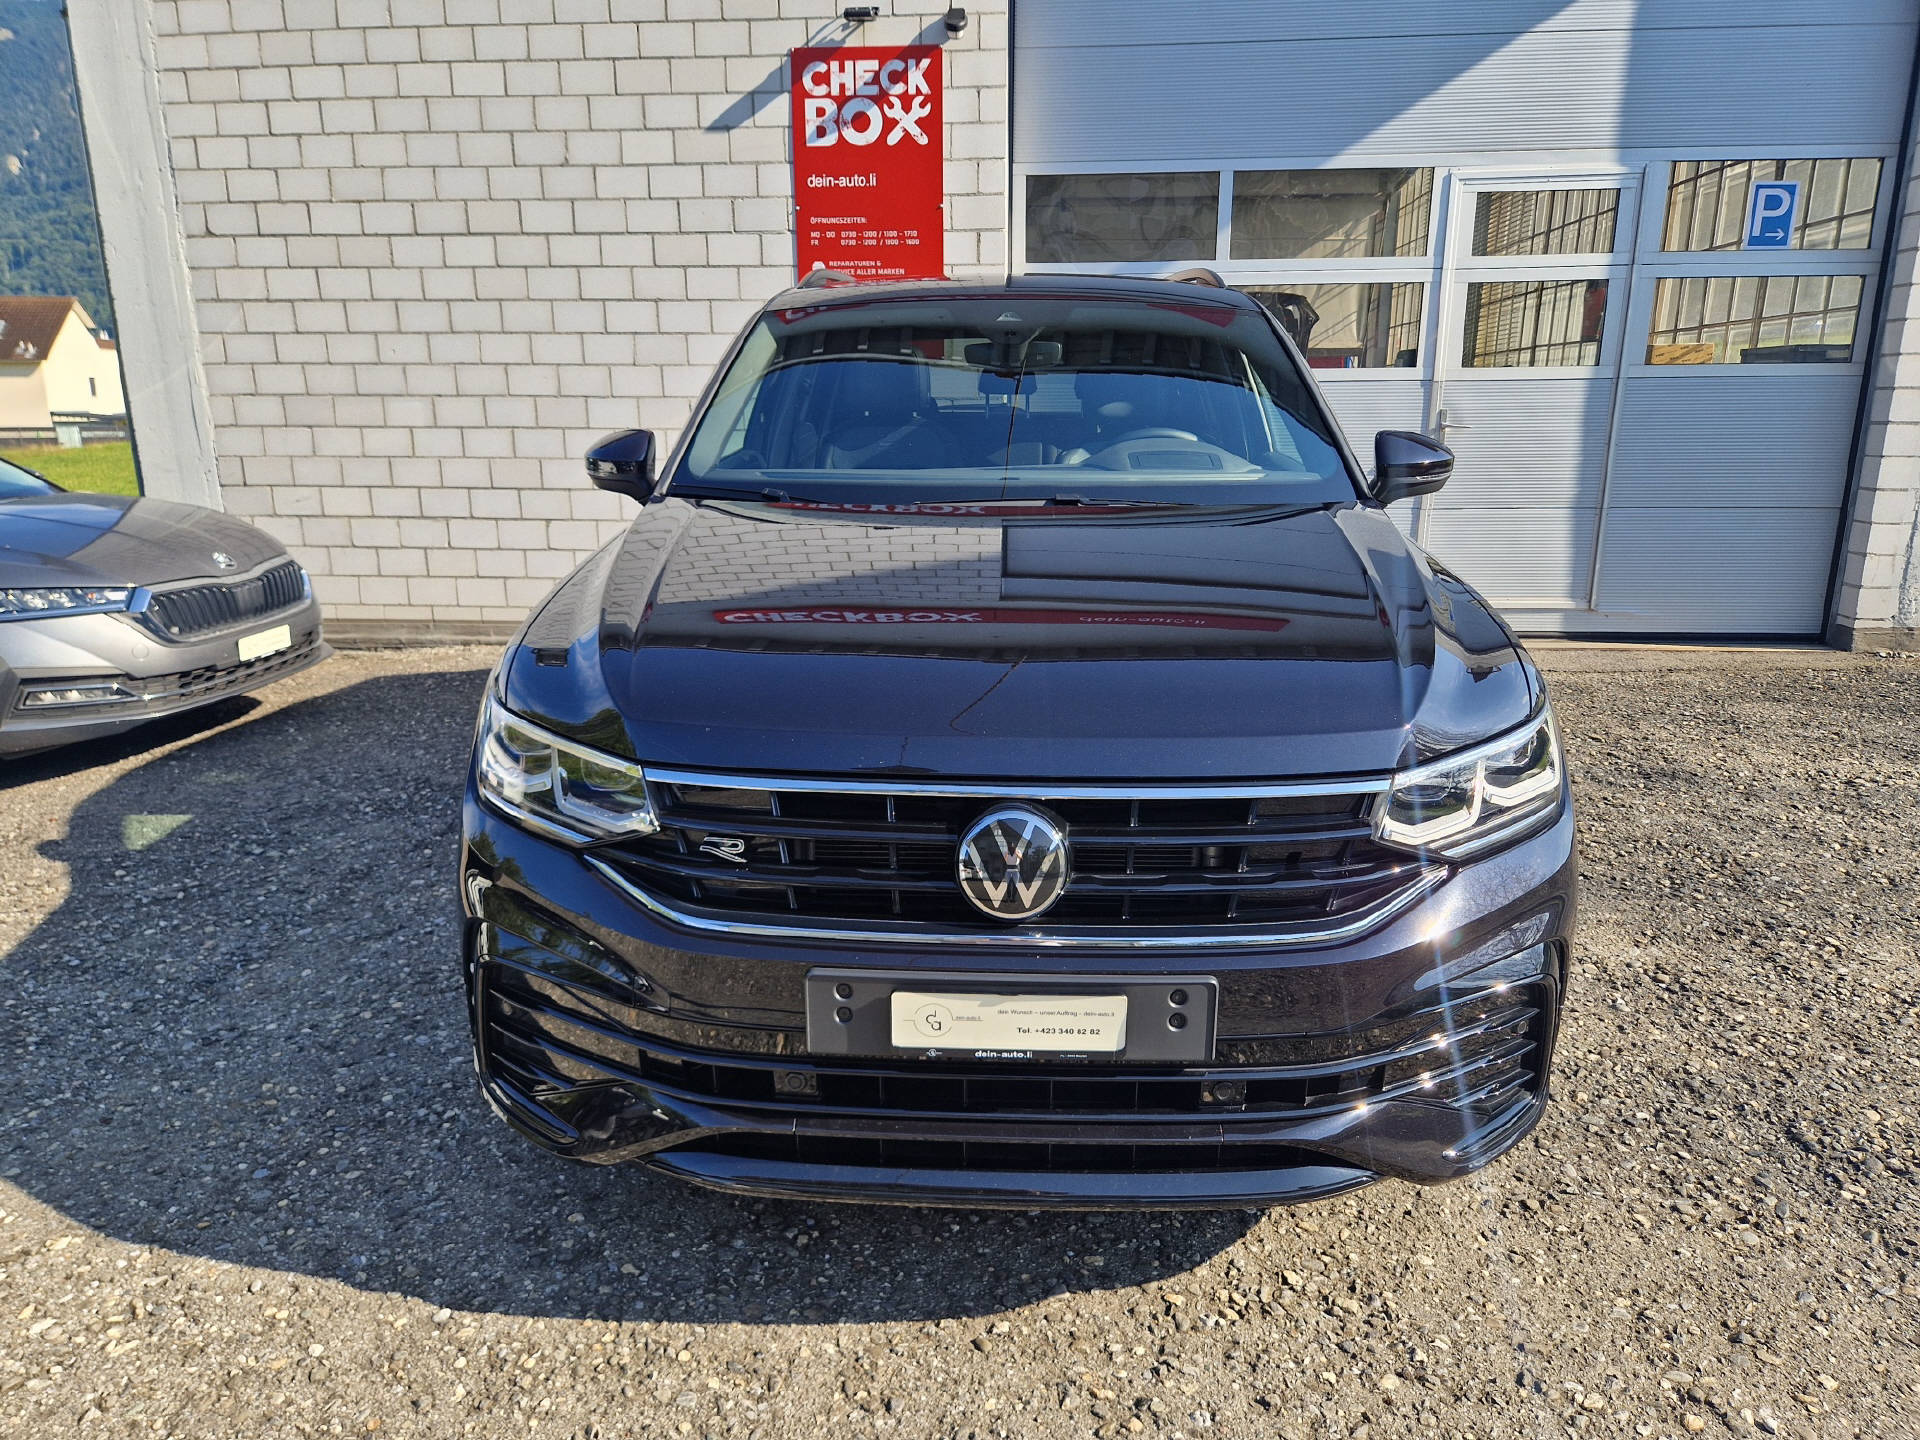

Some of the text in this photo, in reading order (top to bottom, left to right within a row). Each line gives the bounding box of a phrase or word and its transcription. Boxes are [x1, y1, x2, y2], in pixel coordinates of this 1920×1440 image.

[802, 58, 931, 97] CHECK
[804, 96, 931, 147] BOX
[807, 173, 877, 188] dein-auto.li
[1752, 188, 1791, 237] P
[974, 1050, 1033, 1059] dein-auto.li
